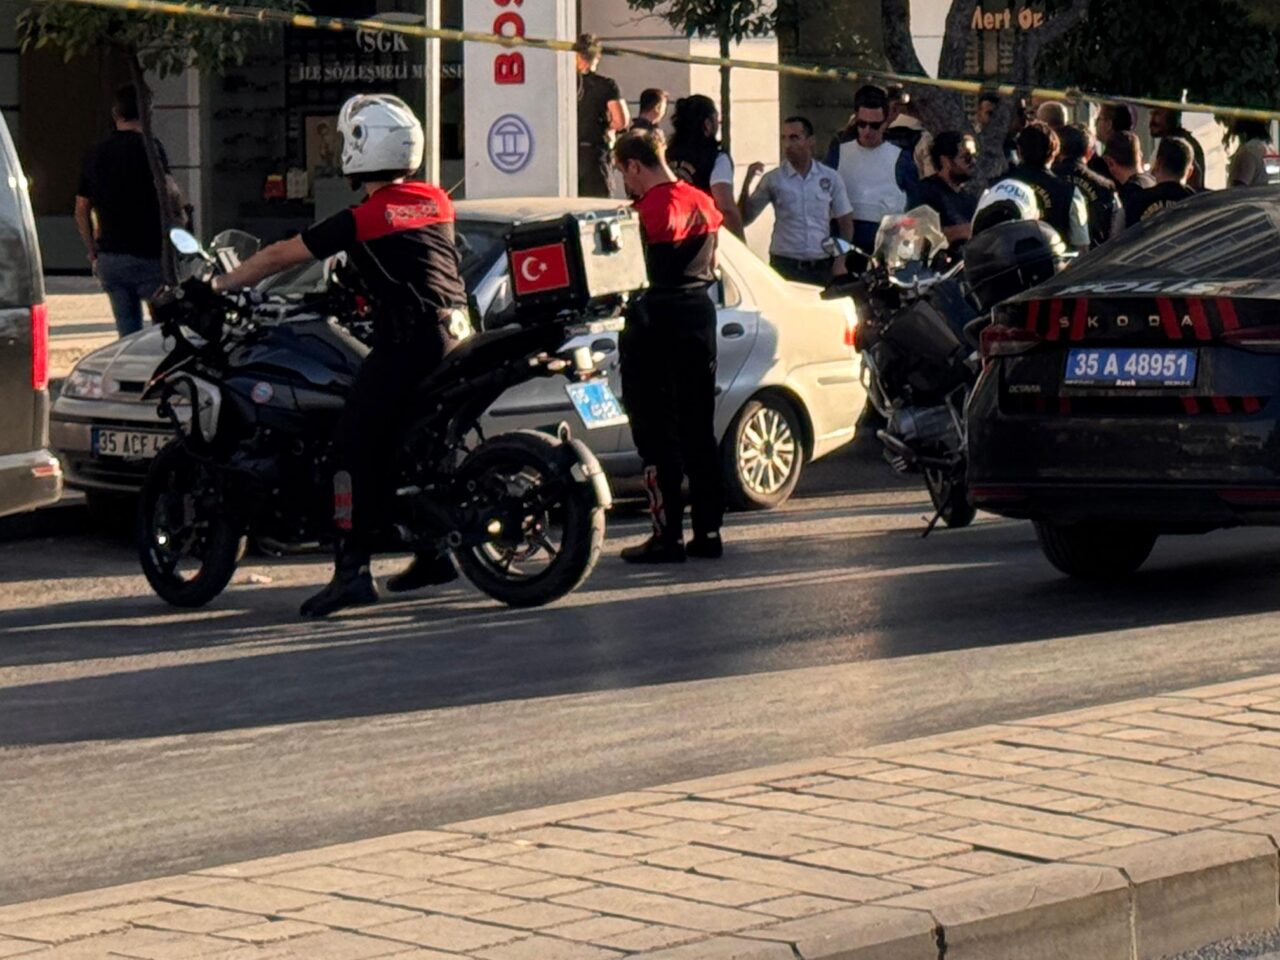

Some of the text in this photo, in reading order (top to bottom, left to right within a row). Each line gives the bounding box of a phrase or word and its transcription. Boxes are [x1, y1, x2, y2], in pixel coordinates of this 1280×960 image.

[1074, 352, 1188, 377] 35 A 48951
[100, 431, 117, 452] 35
[123, 433, 148, 454] ACF
